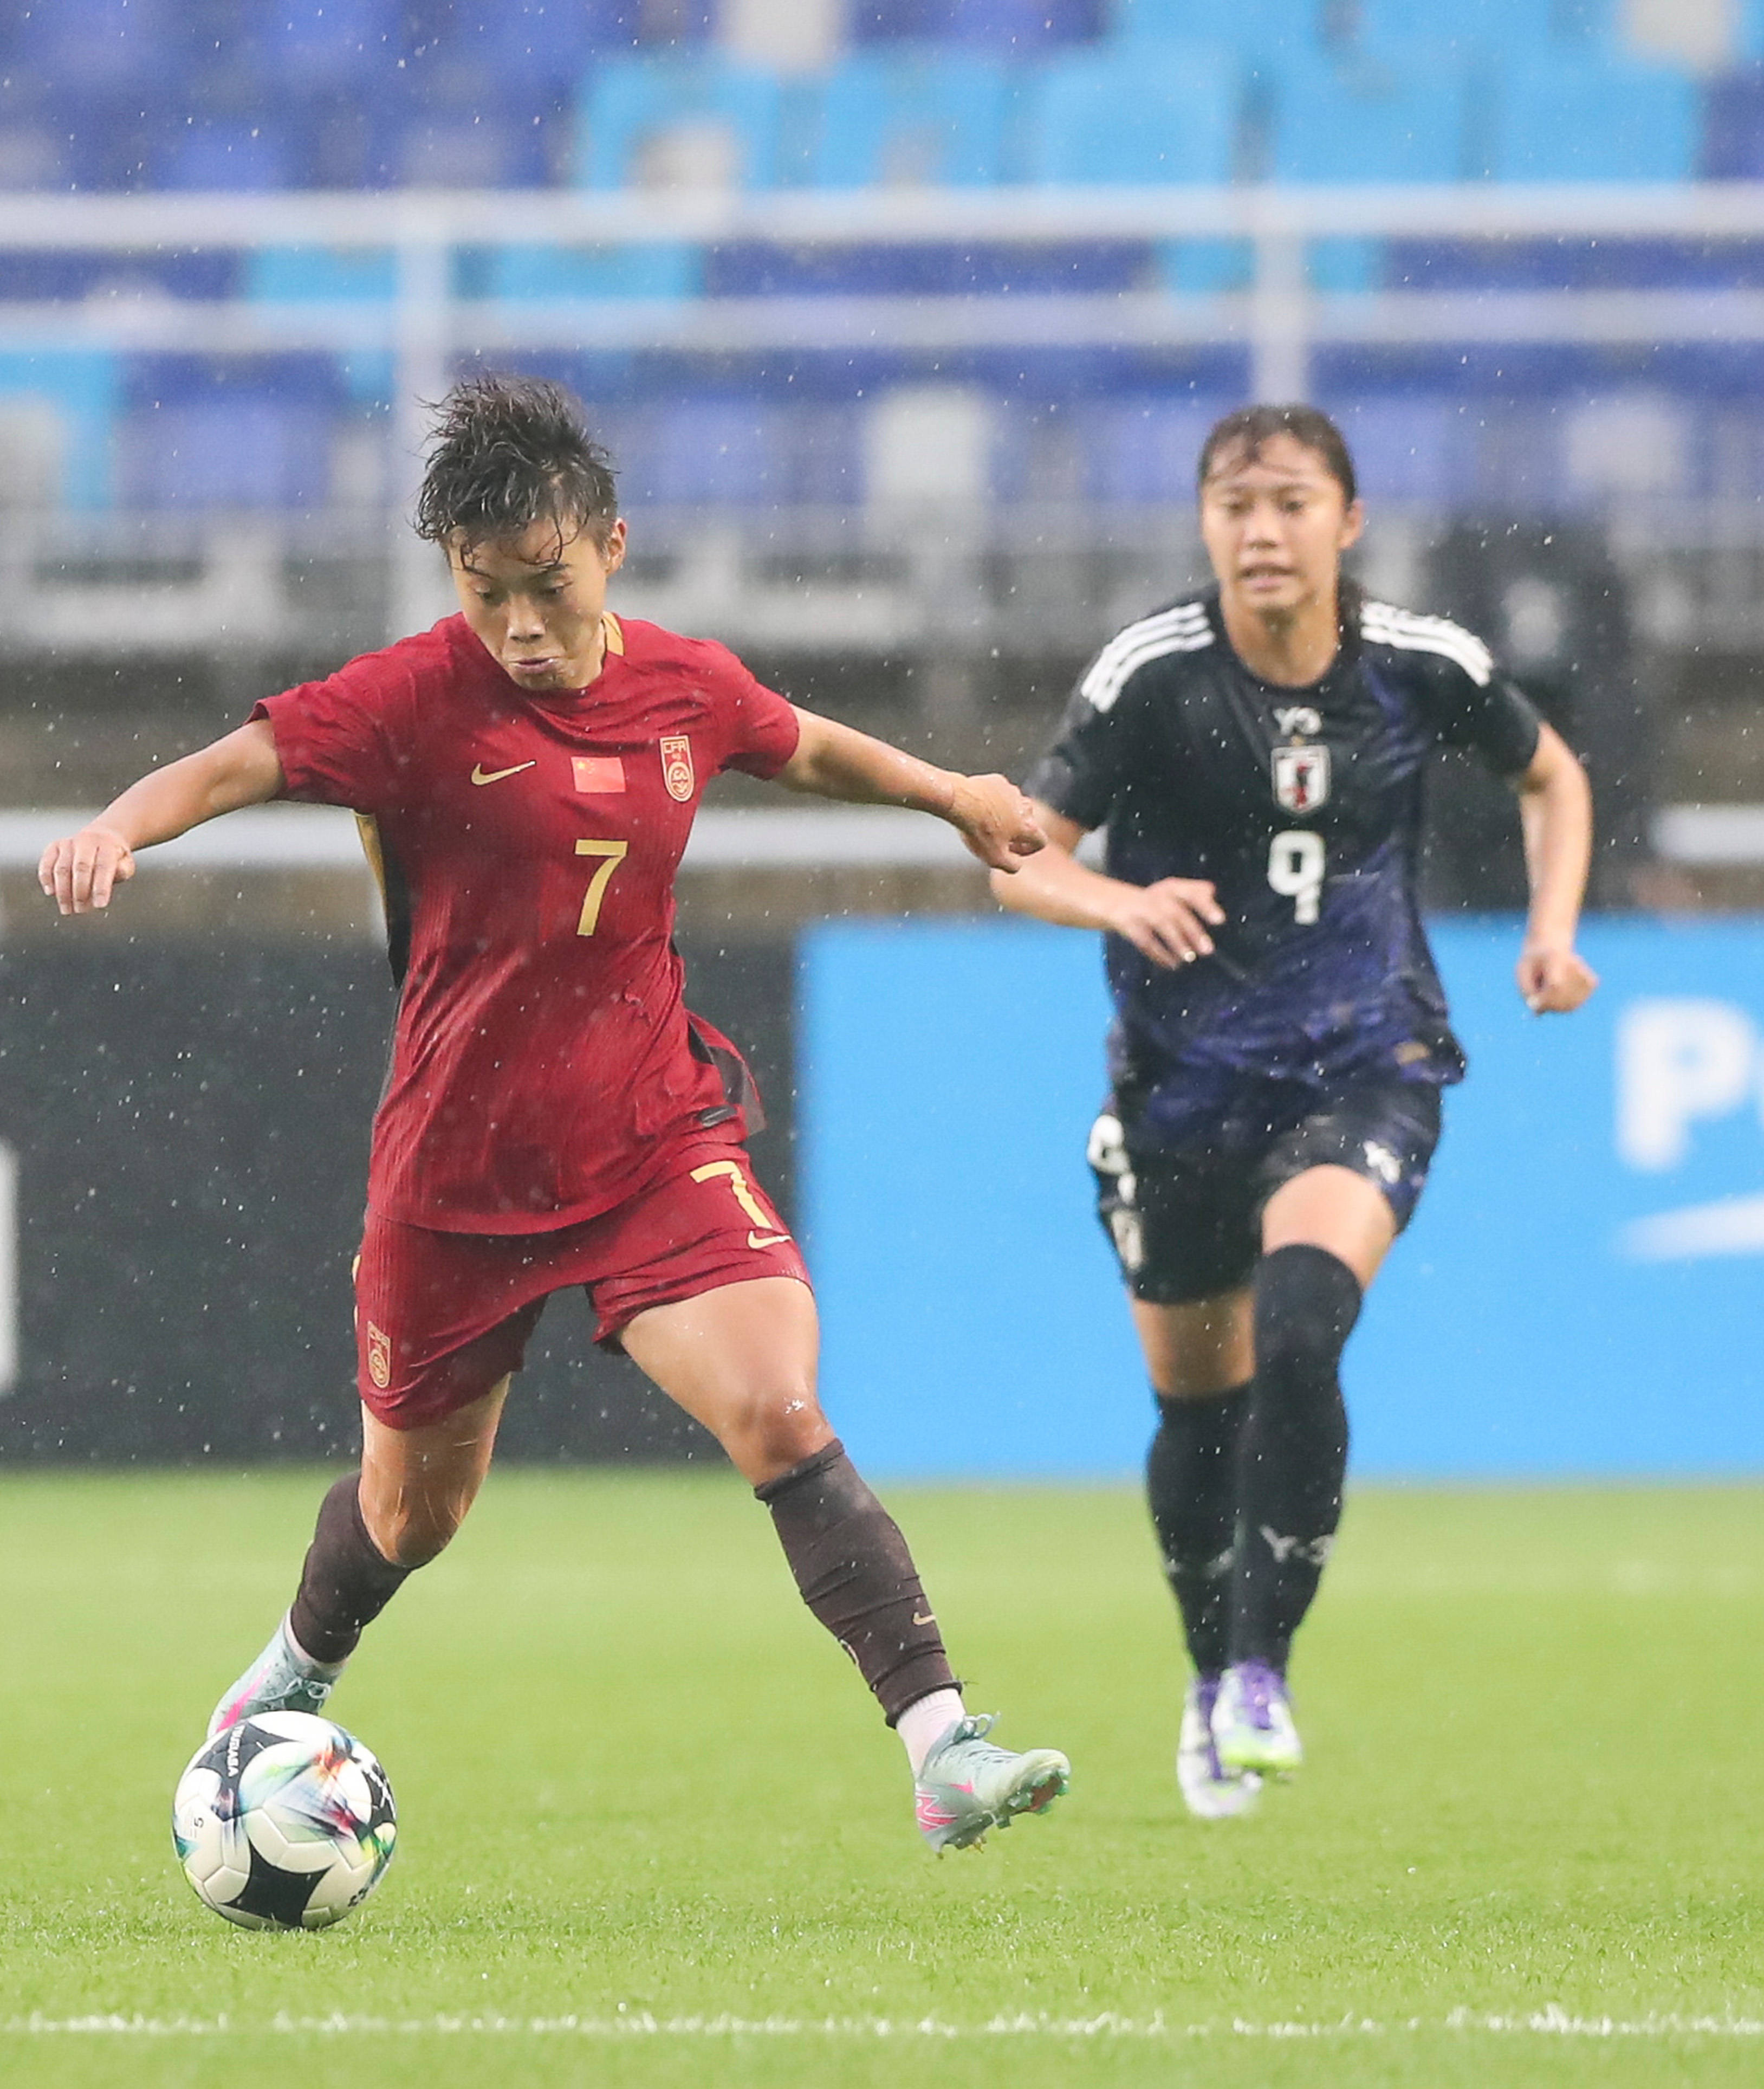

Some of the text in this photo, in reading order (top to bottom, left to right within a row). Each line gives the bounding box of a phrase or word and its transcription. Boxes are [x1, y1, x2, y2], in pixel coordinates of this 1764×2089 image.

[575, 839, 628, 936] 7
[1268, 830, 1325, 924] 9
[690, 1160, 773, 1229] 7
